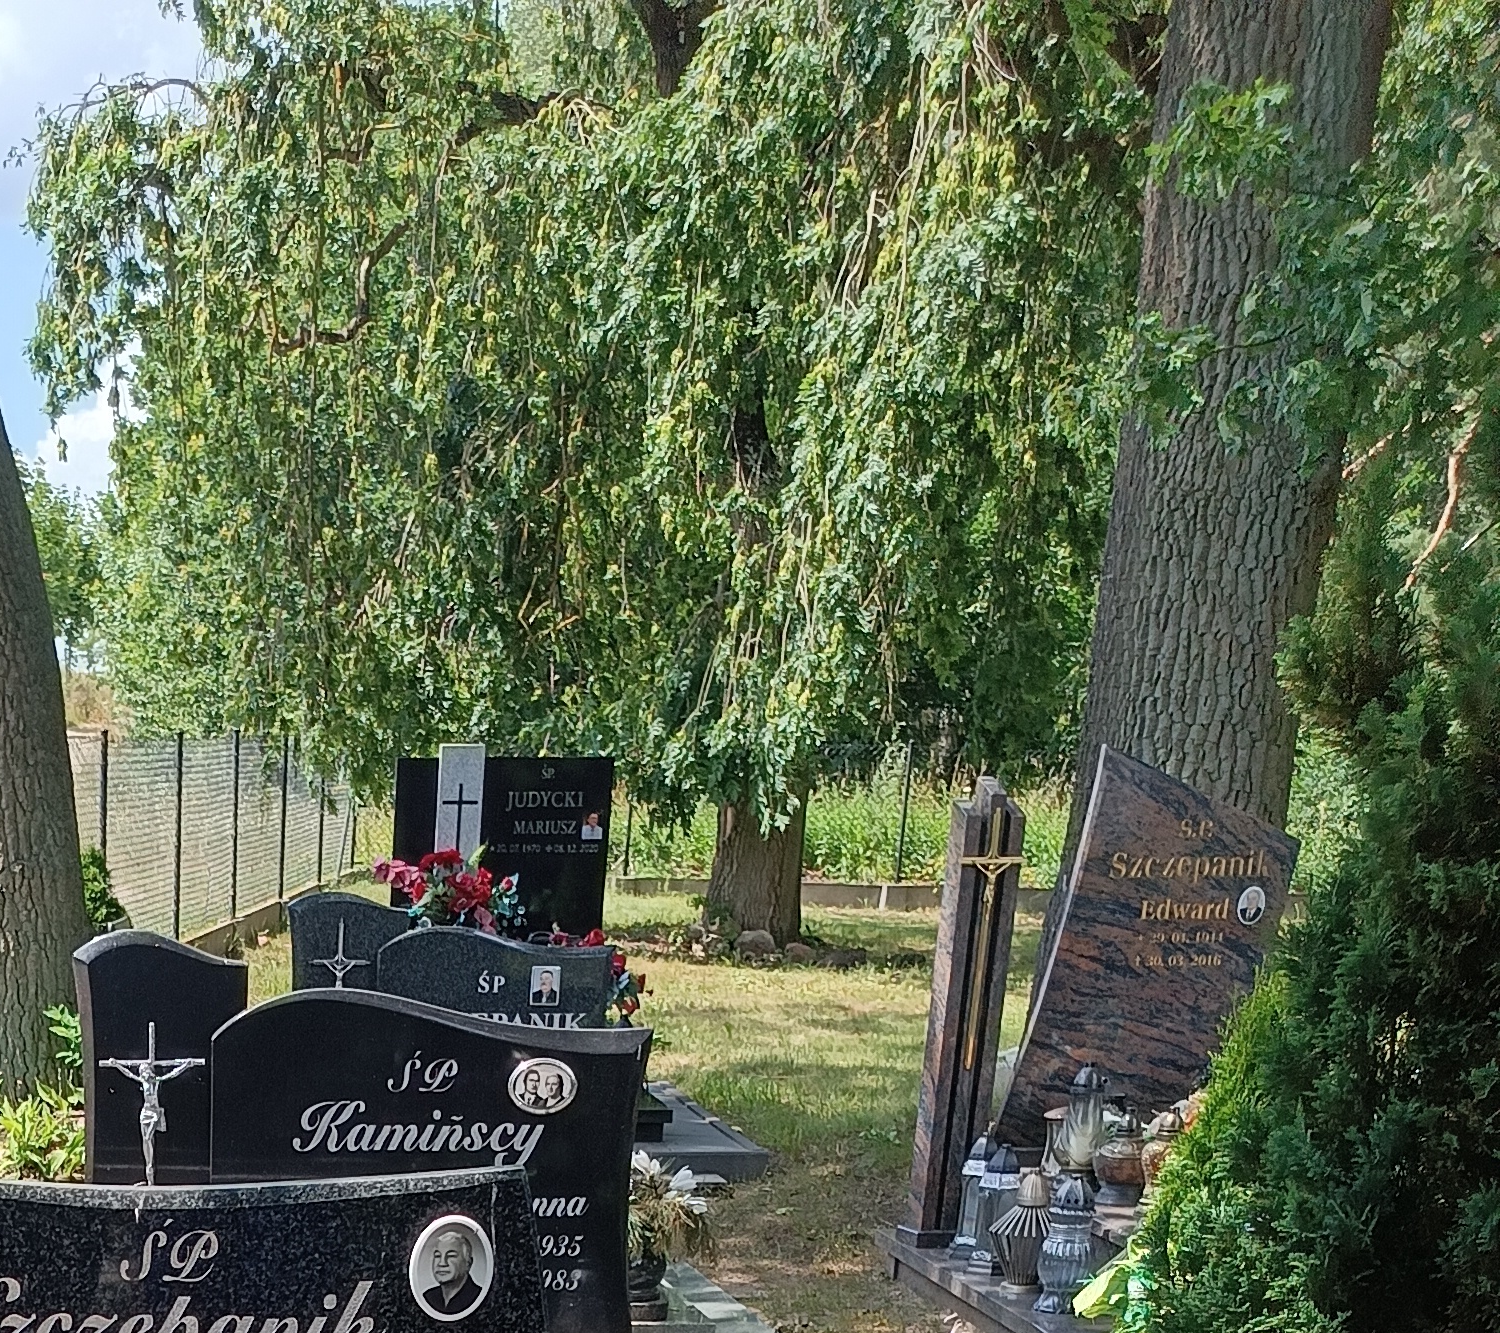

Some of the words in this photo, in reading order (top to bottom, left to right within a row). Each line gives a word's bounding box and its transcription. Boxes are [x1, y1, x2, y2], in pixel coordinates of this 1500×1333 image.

[505, 791, 584, 812] JUDYCKI
[513, 820, 577, 835] MARIUSZ
[1109, 850, 1269, 883] Szczepanik
[1139, 898, 1230, 920] Edward
[477, 970, 505, 994] ŚP
[532, 1196, 590, 1218] nna
[539, 1234, 584, 1257] 935
[542, 1268, 582, 1291] 983
